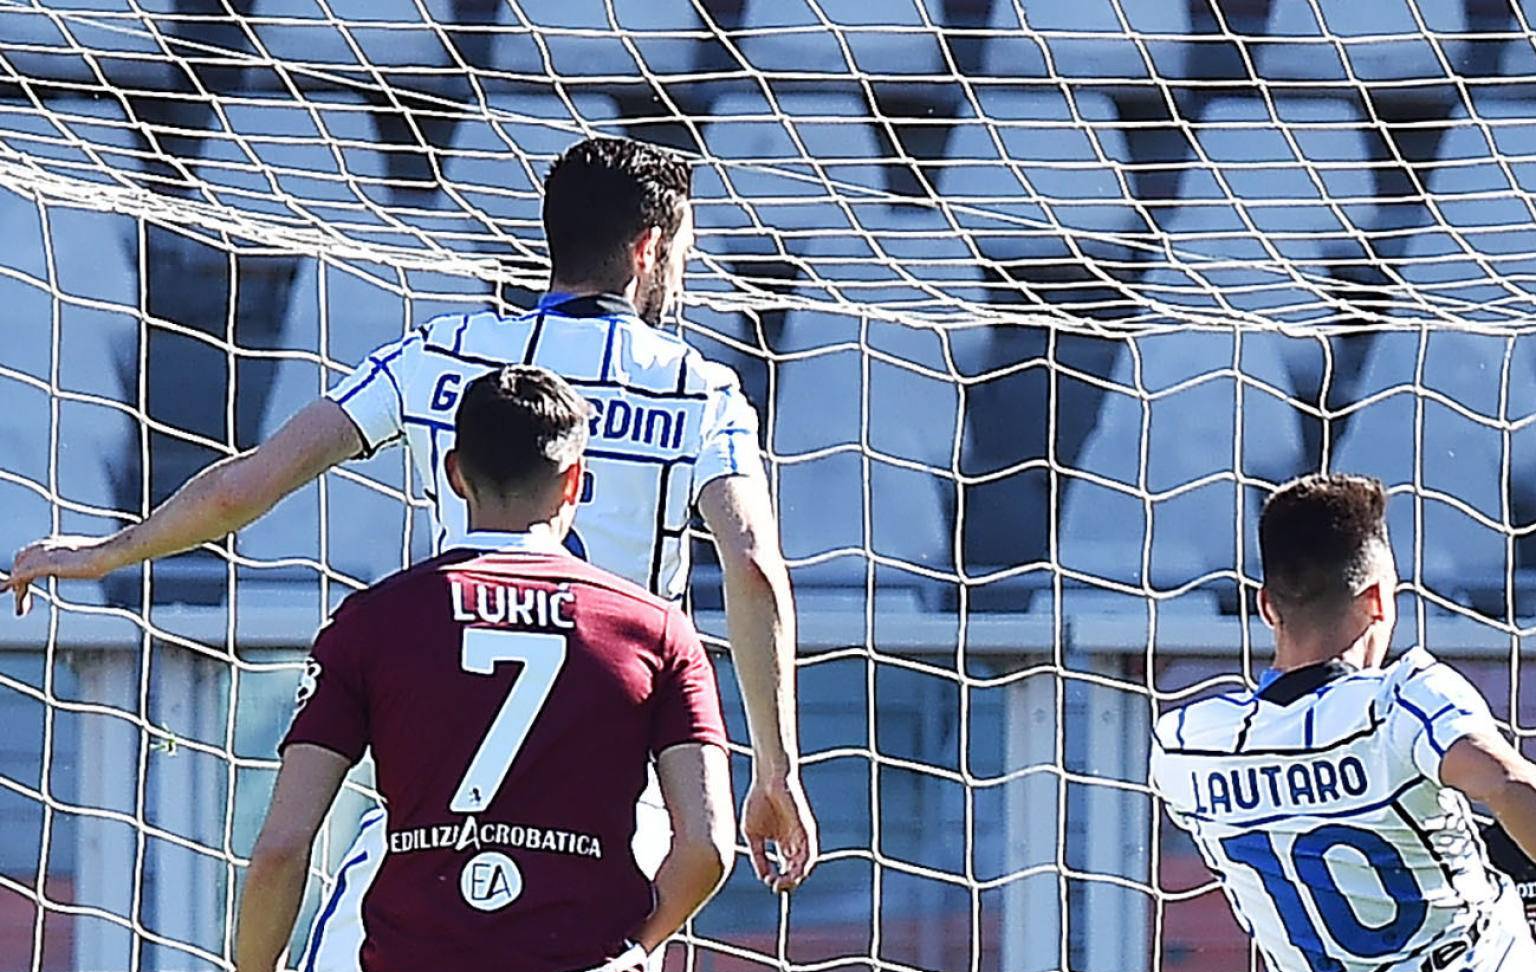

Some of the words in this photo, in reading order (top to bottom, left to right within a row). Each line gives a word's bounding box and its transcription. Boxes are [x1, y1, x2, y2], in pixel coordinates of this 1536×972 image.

[450, 581, 575, 629] LUKIĆ
[449, 626, 567, 813] 7
[1191, 755, 1369, 814] LAUTARO
[471, 863, 512, 901] EA
